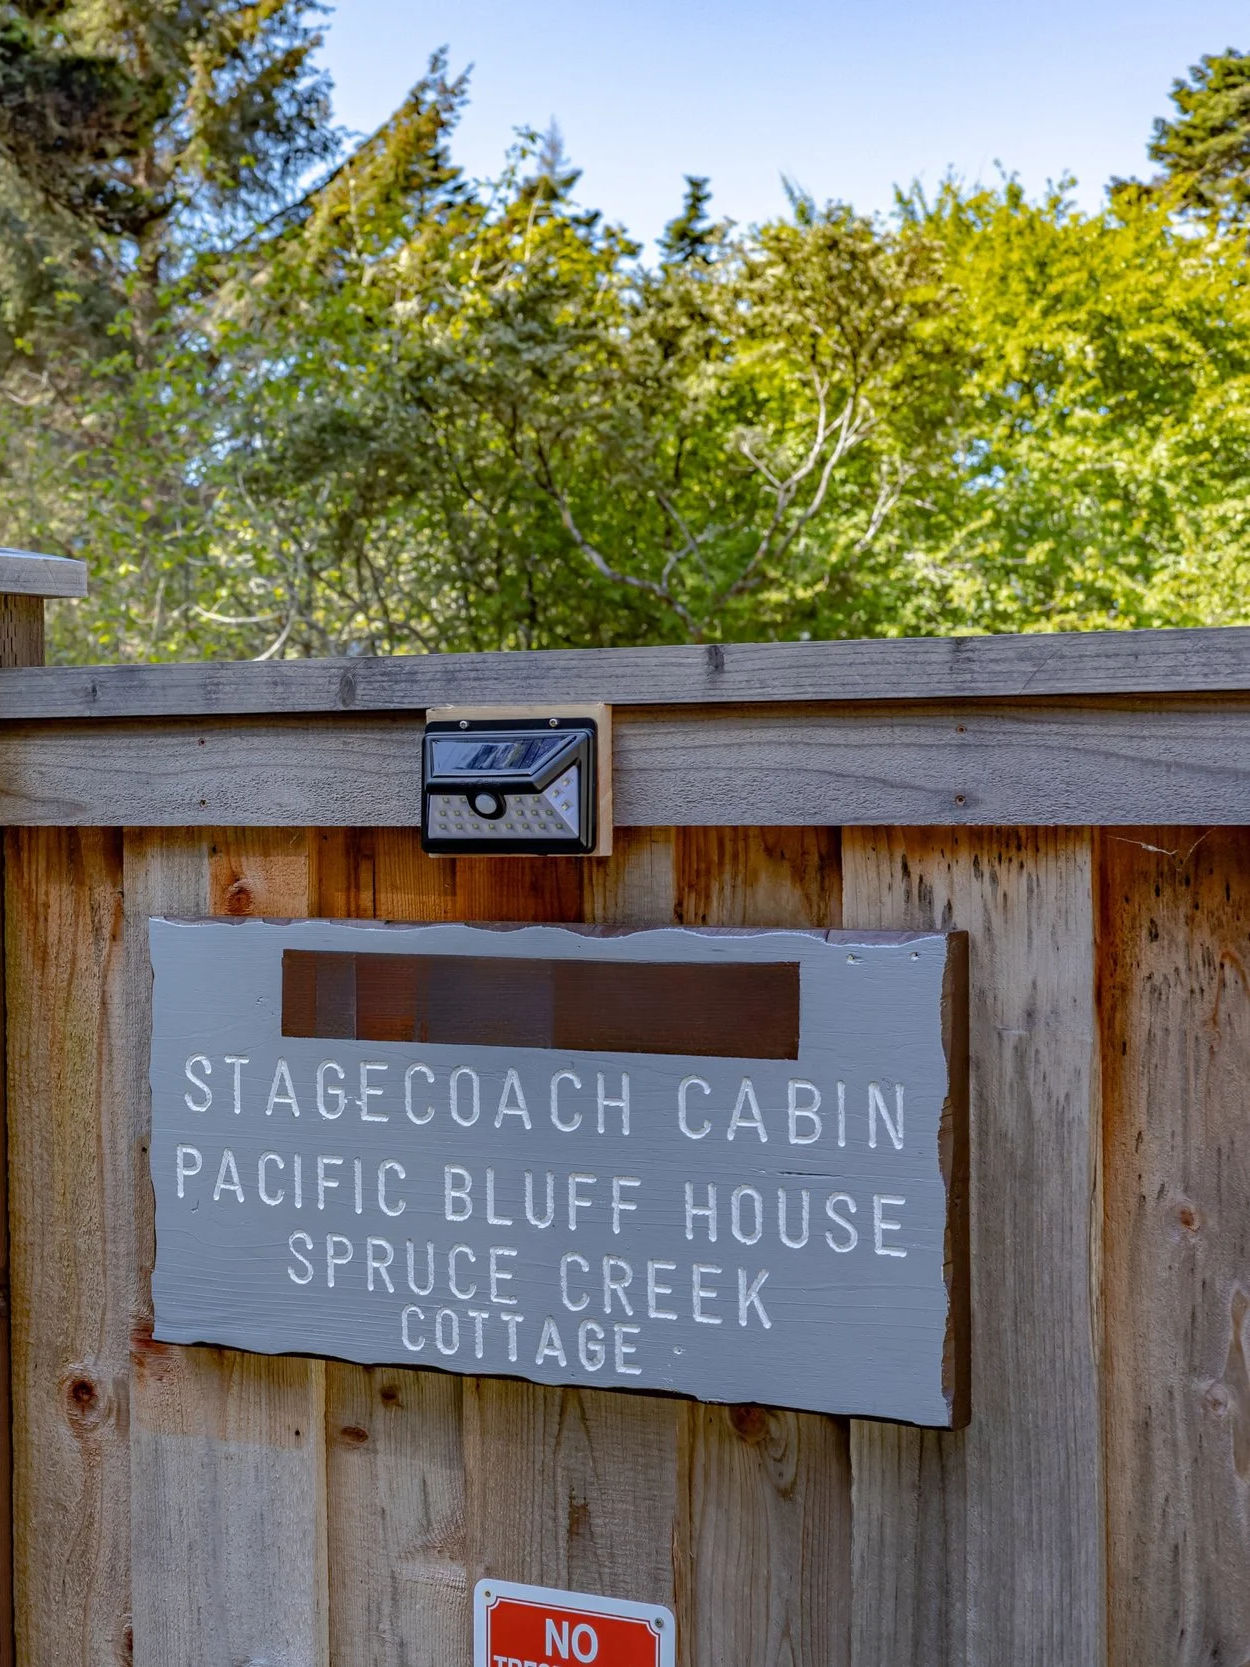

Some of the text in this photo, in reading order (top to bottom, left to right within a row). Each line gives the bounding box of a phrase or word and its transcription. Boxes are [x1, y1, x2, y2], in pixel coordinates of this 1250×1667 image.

[185, 1053, 906, 1150] STAGECOACH CABIN
[176, 1143, 908, 1258] PACIFIC BLUFF HOUSE
[288, 1230, 772, 1329] SPRUCE CREEK
[401, 1303, 642, 1375] COTTAGE
[545, 1618, 598, 1663] NO
